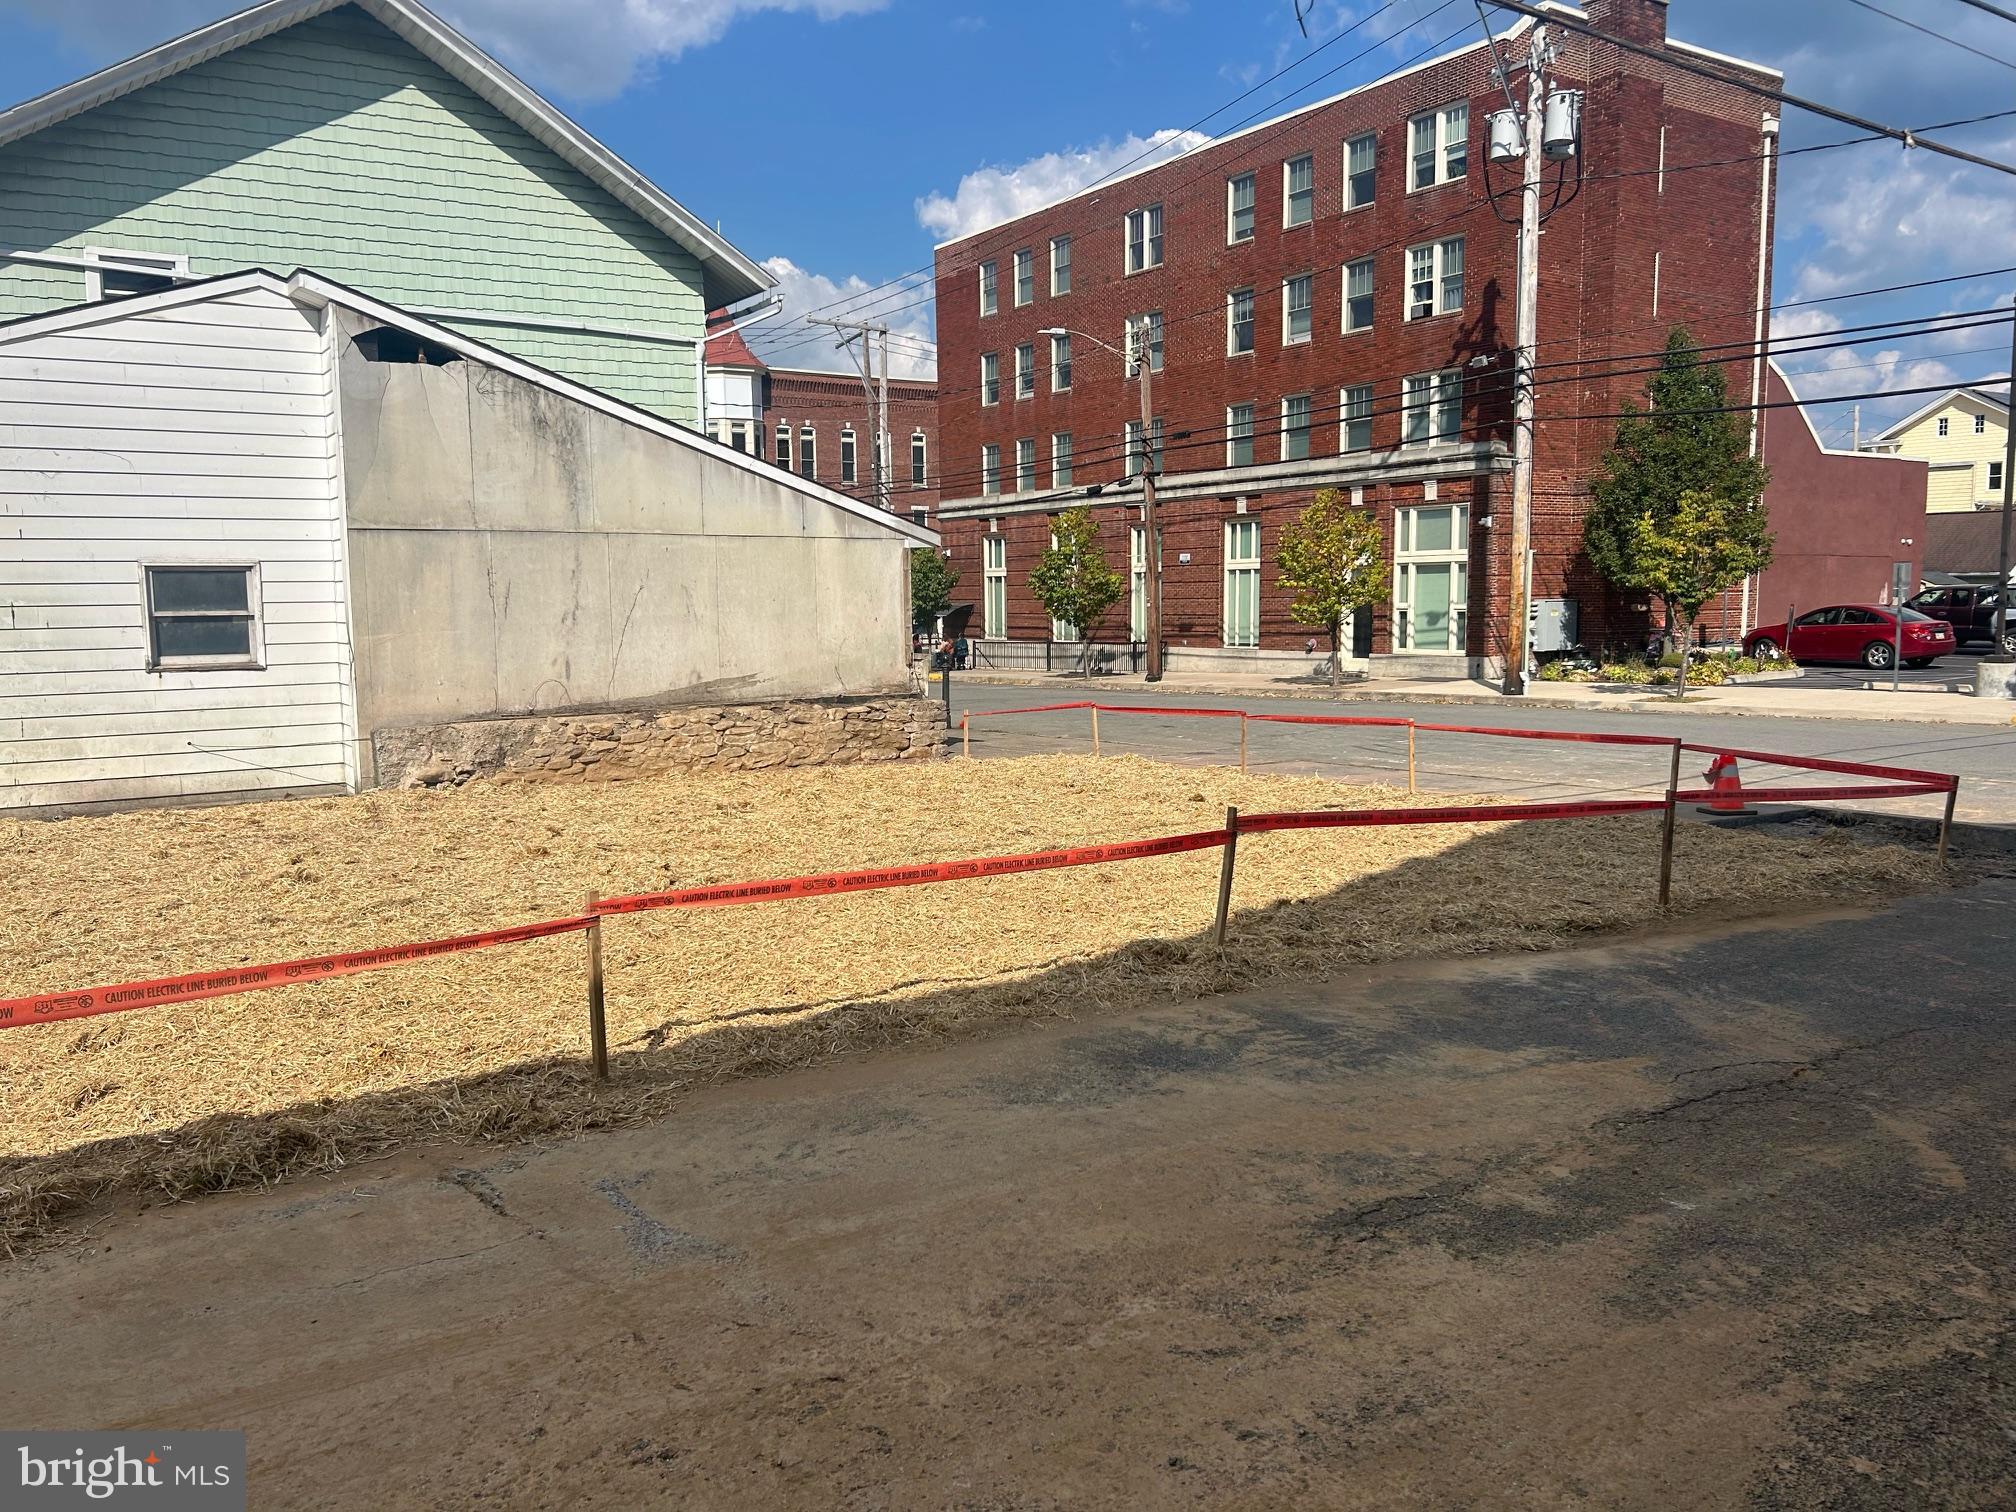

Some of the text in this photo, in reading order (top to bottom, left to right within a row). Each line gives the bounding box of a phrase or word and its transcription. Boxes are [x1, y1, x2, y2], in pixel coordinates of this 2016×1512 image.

[843, 876, 866, 886] CAUTION
[867, 873, 889, 883] ELECTRIC
[682, 883, 791, 902] CAUTION ELECTRIC LINE BURIED BELOW
[344, 939, 480, 968] CAUTION ELECTRIC LINE BURIED BELOW
[105, 971, 268, 1003] CAUTION ELECTRIC LINE BURIED BELOW
